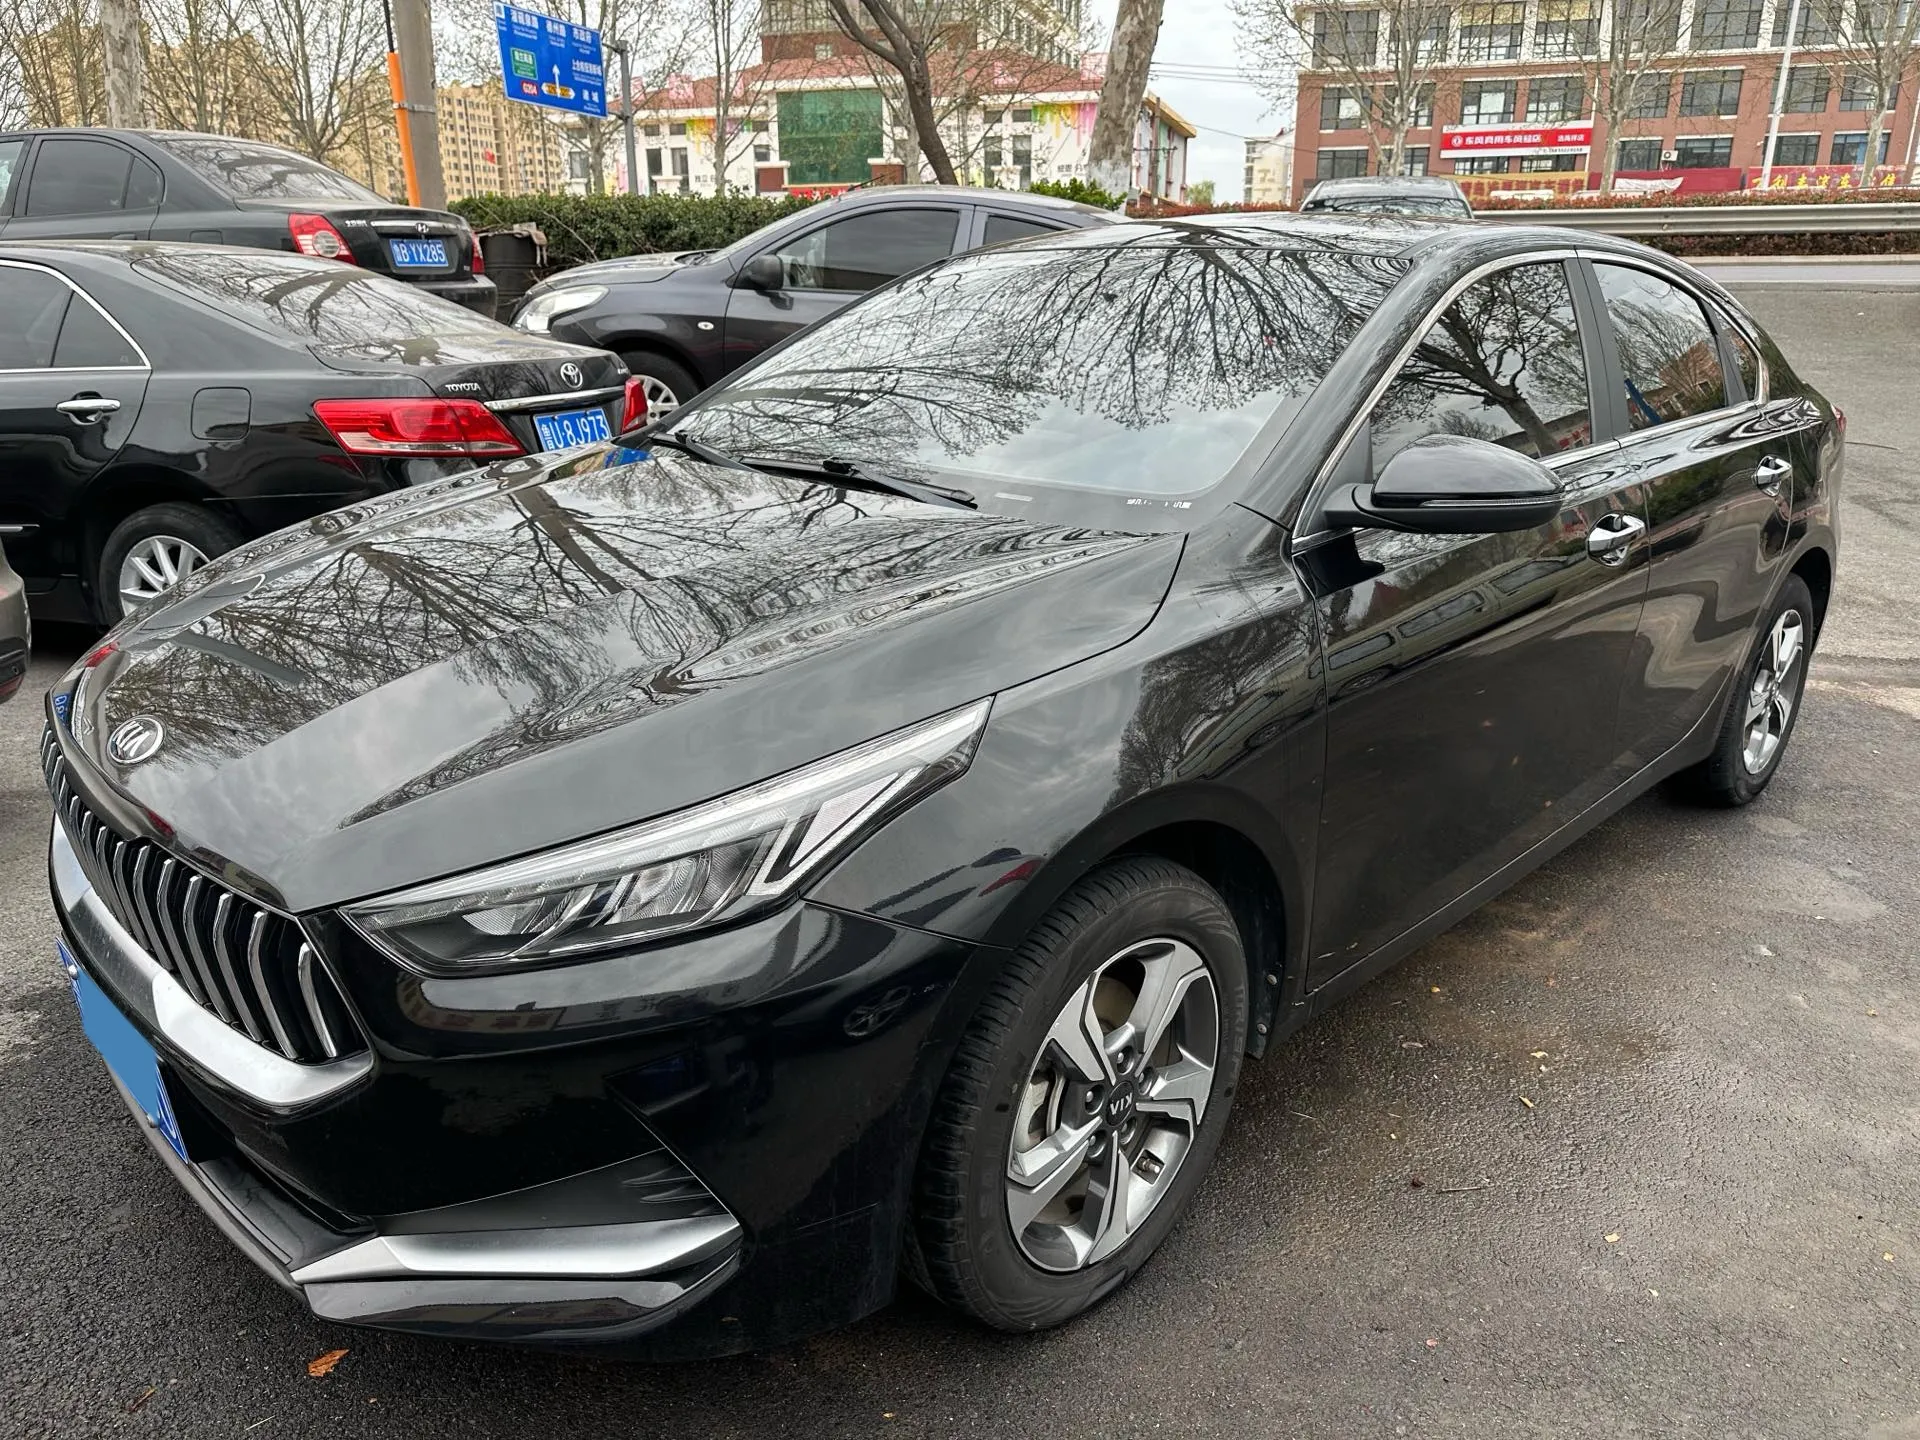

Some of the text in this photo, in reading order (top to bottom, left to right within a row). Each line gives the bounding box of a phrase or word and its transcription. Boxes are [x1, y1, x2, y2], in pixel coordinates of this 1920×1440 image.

[445, 382, 481, 393] TOYOTA
[113, 720, 150, 757] KIA
[1110, 1092, 1133, 1115] KIA
